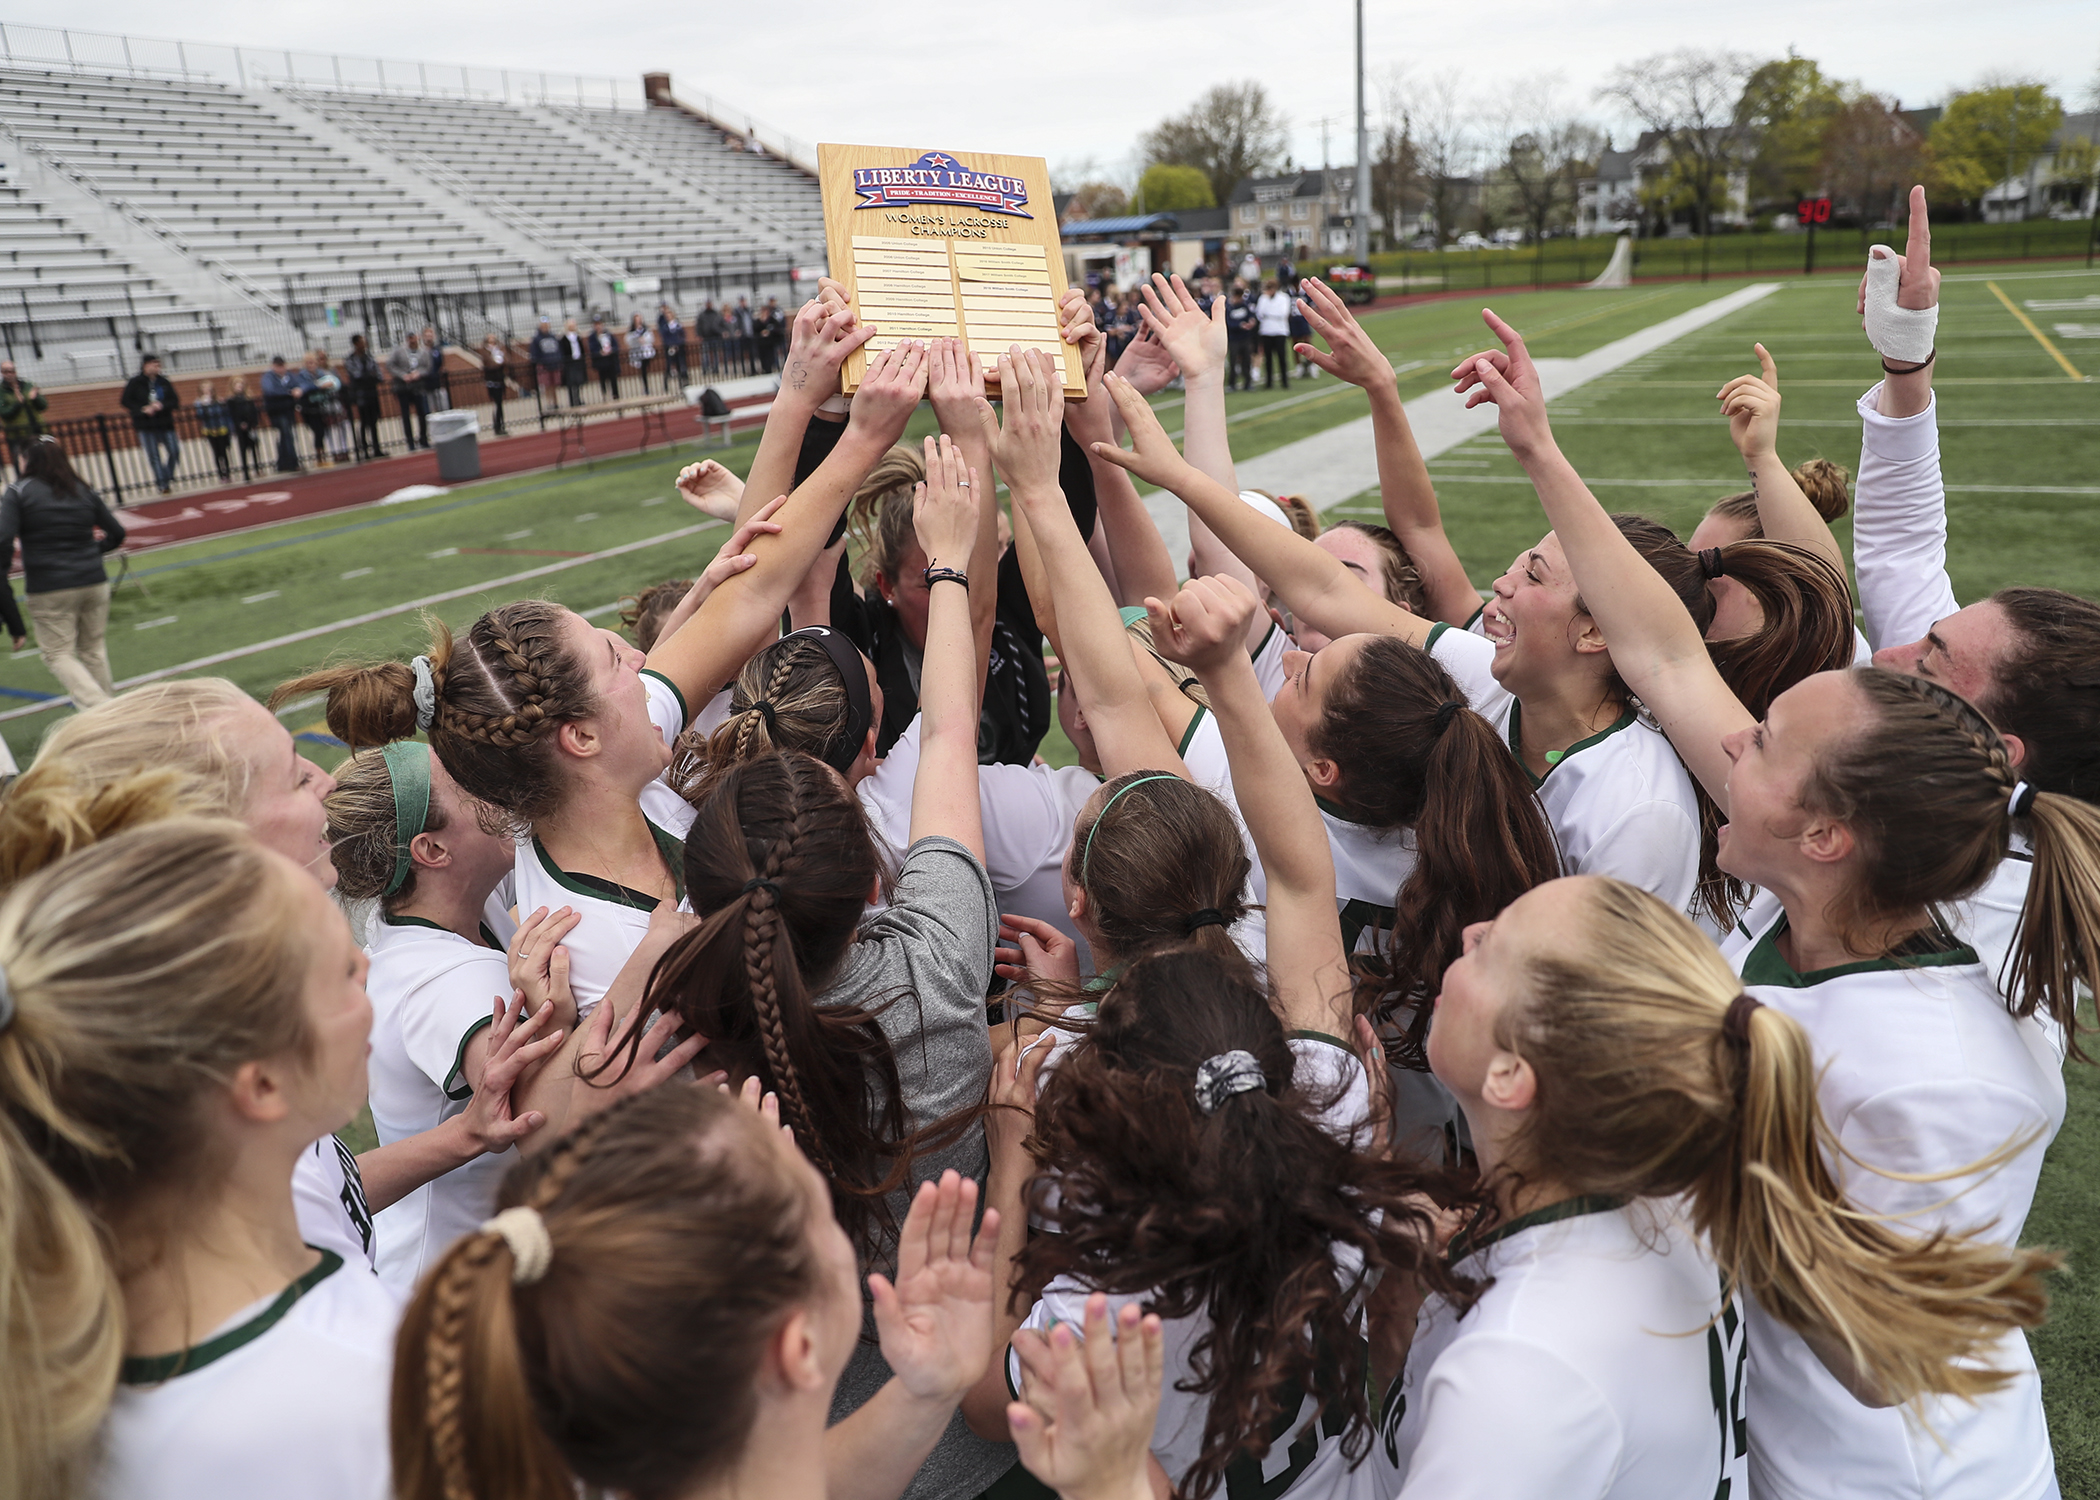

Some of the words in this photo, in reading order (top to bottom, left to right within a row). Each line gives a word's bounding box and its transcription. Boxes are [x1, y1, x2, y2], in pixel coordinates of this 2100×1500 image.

[857, 169, 941, 188] LIBERTY
[947, 170, 1027, 197] LEAGUE
[889, 189, 911, 197] PRIDE
[914, 190, 951, 198] TRADITION
[954, 192, 998, 202] EXCELLENCE
[1797, 197, 1832, 224] 90
[885, 212, 945, 225] WOMEN'S
[949, 216, 1009, 229] LACROSSE
[911, 225, 988, 239] CHAMPIONS
